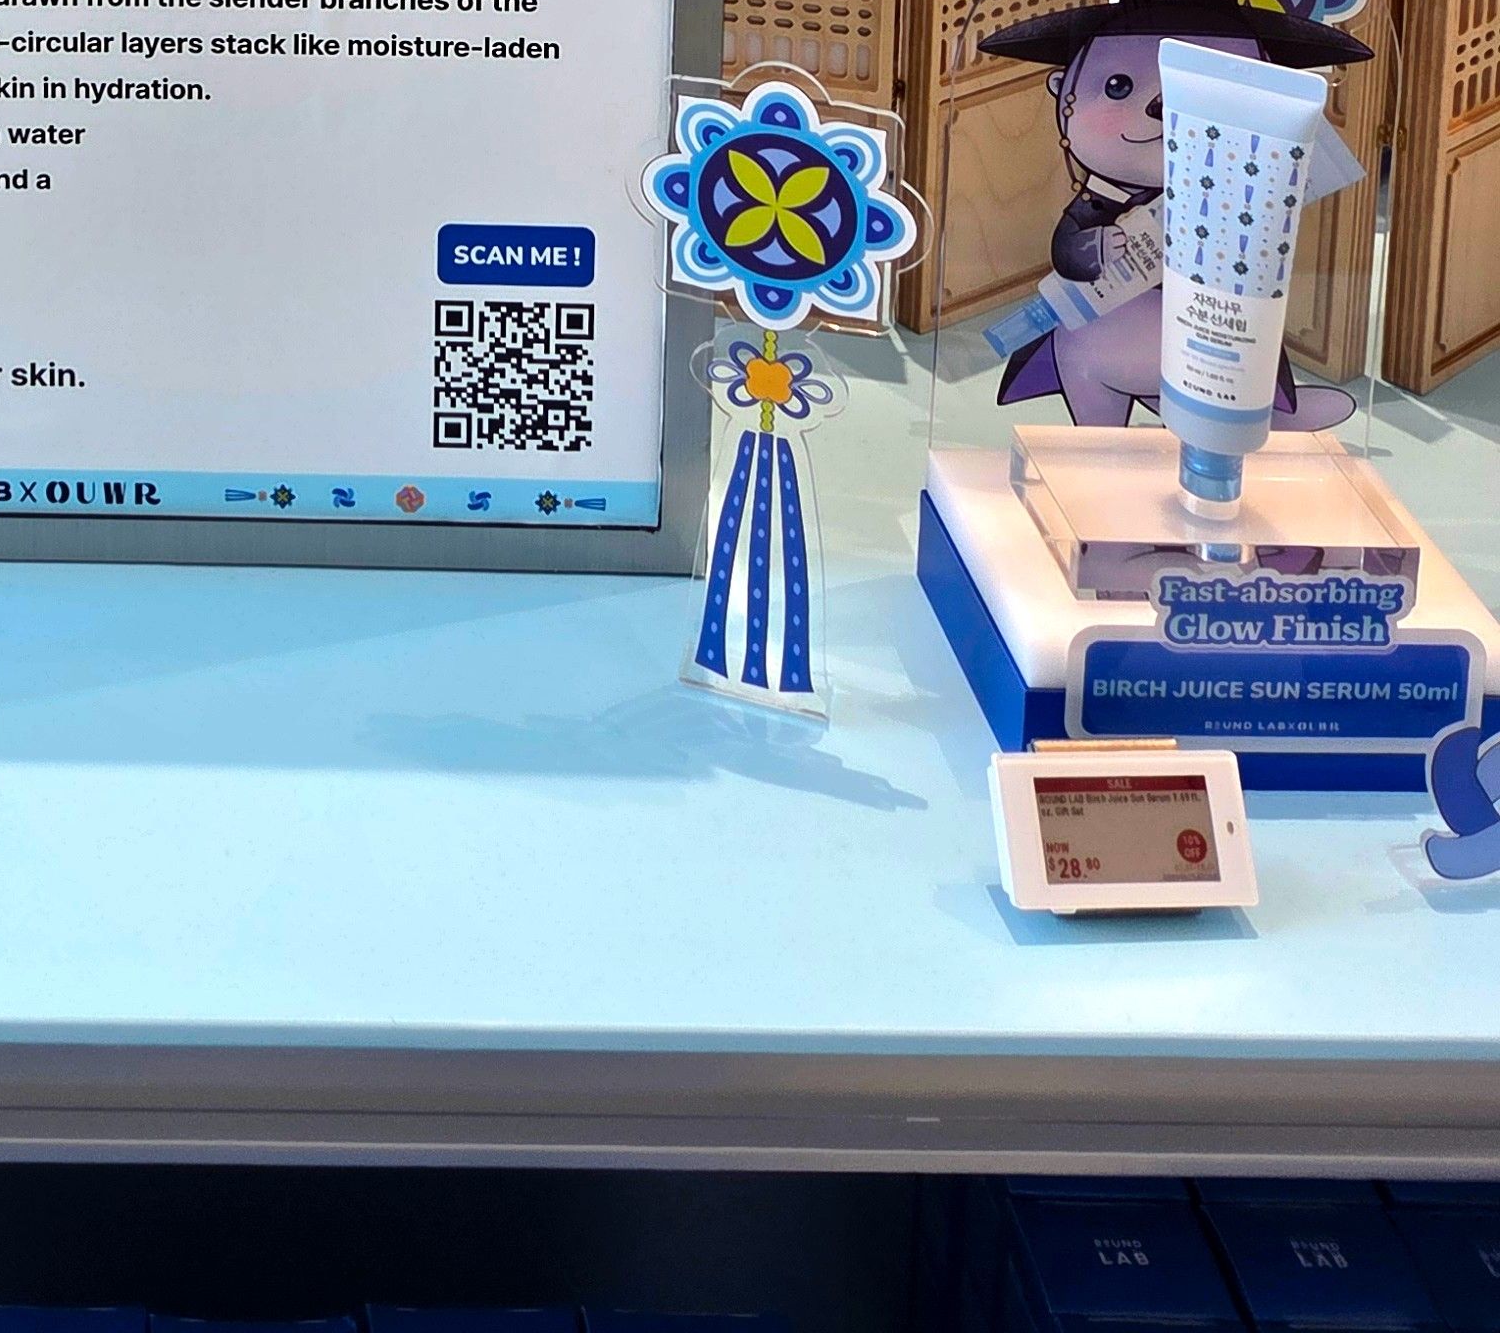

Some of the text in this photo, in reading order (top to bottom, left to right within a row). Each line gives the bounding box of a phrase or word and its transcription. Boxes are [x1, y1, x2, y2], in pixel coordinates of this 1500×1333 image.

[6, 124, 87, 146] water
[35, 173, 52, 191] a
[454, 244, 524, 265] SCAN
[530, 246, 568, 266] ME
[10, 361, 86, 388] skin.
[1163, 579, 1398, 610] Fast-absorbing
[1168, 613, 1385, 642] Glow Finish
[1092, 679, 1459, 701] BIRCH JUICE SUN SERUM 50ml
[1107, 778, 1133, 789] SALE
[1099, 1251, 1149, 1266] LAB
[1295, 1250, 1349, 1269] LAB
